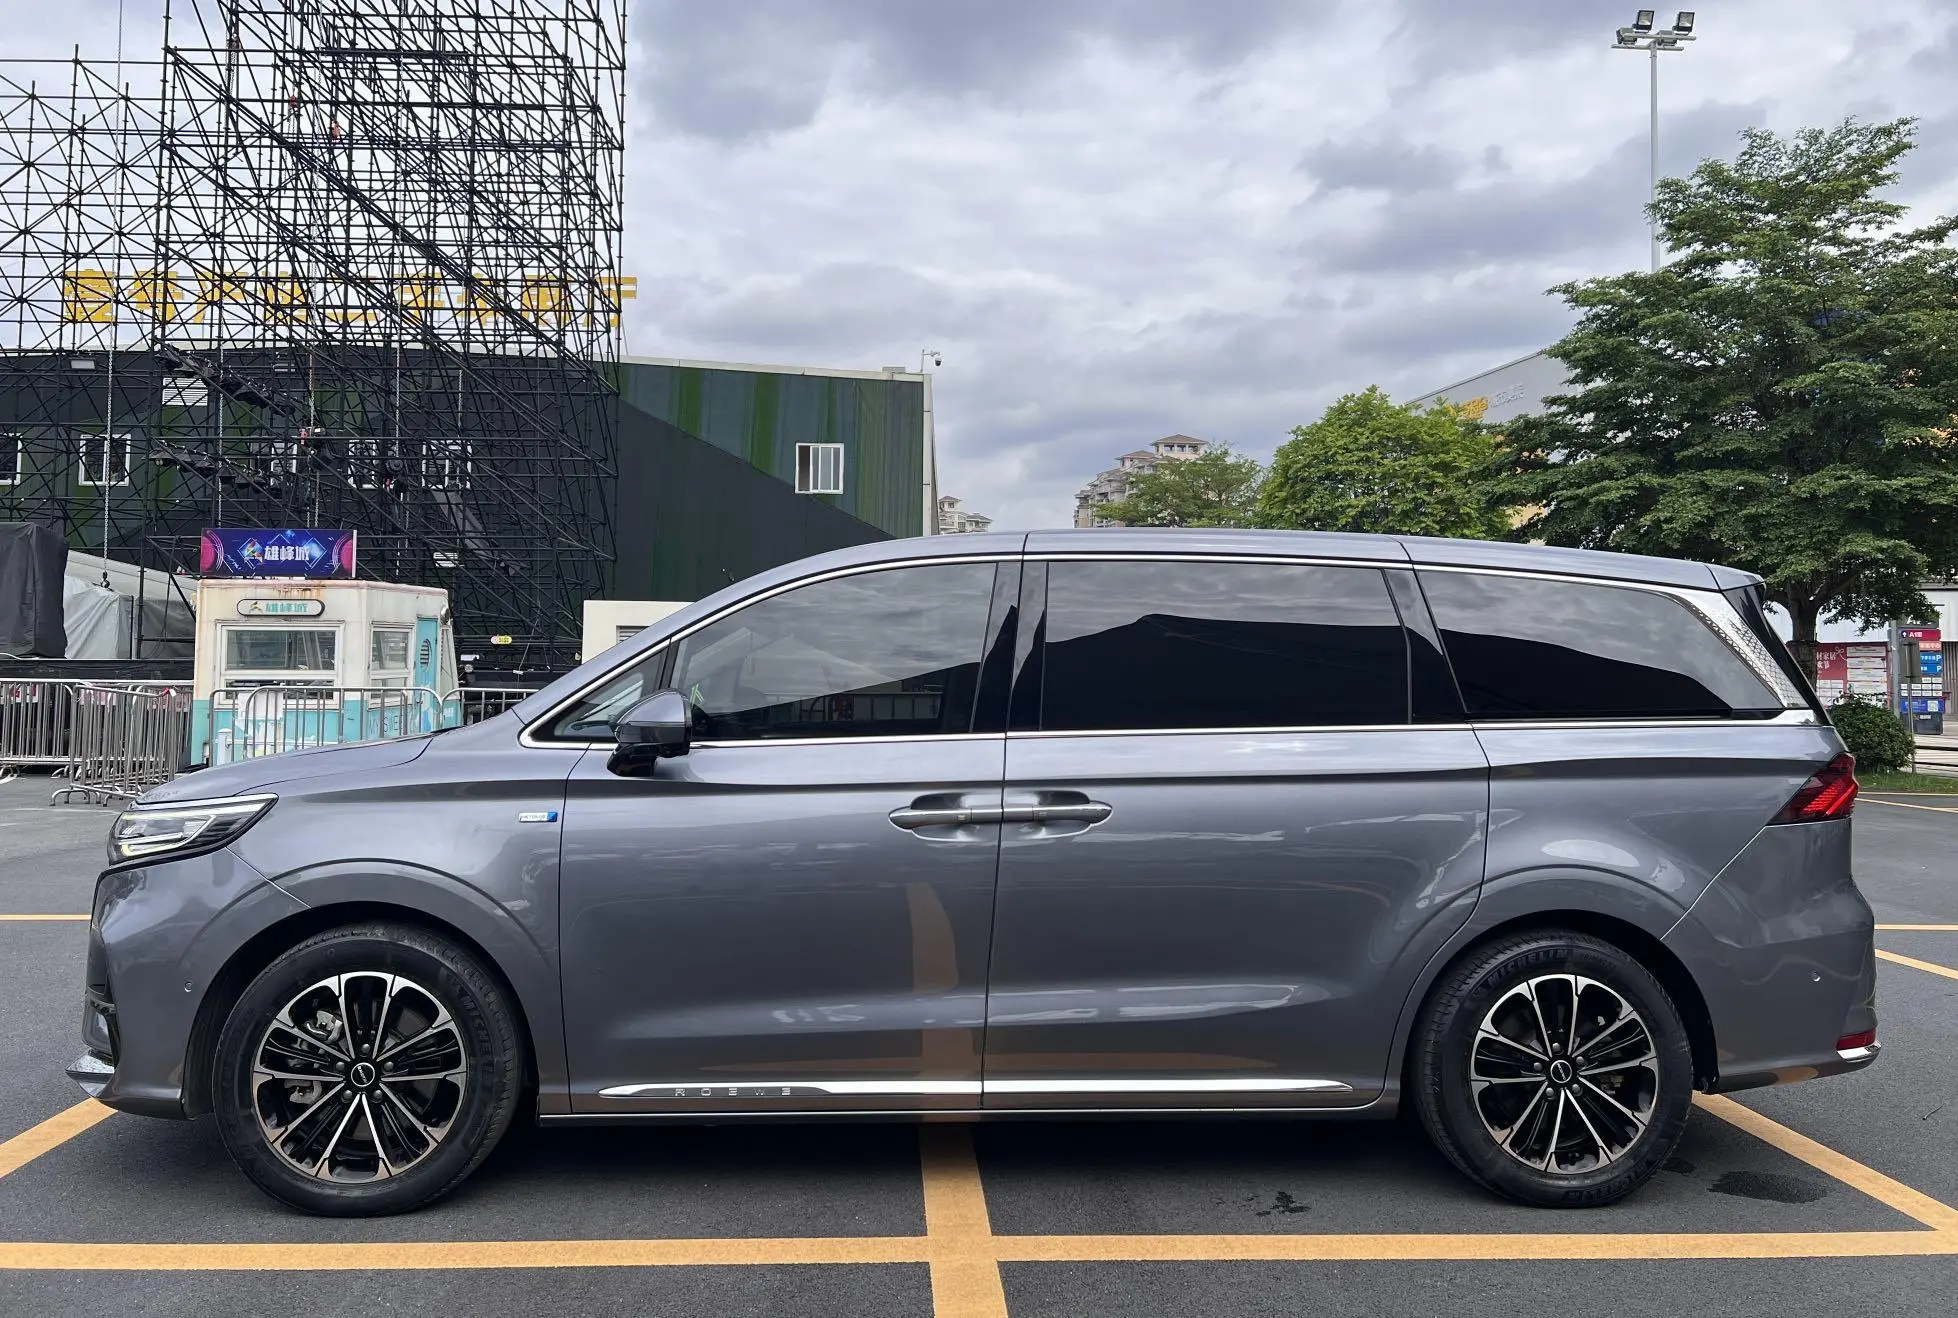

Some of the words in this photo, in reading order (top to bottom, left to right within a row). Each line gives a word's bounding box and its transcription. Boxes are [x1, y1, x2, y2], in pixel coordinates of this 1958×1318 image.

[264, 545, 310, 561] 雄峰城
[675, 1087, 791, 1096] ROEWE
